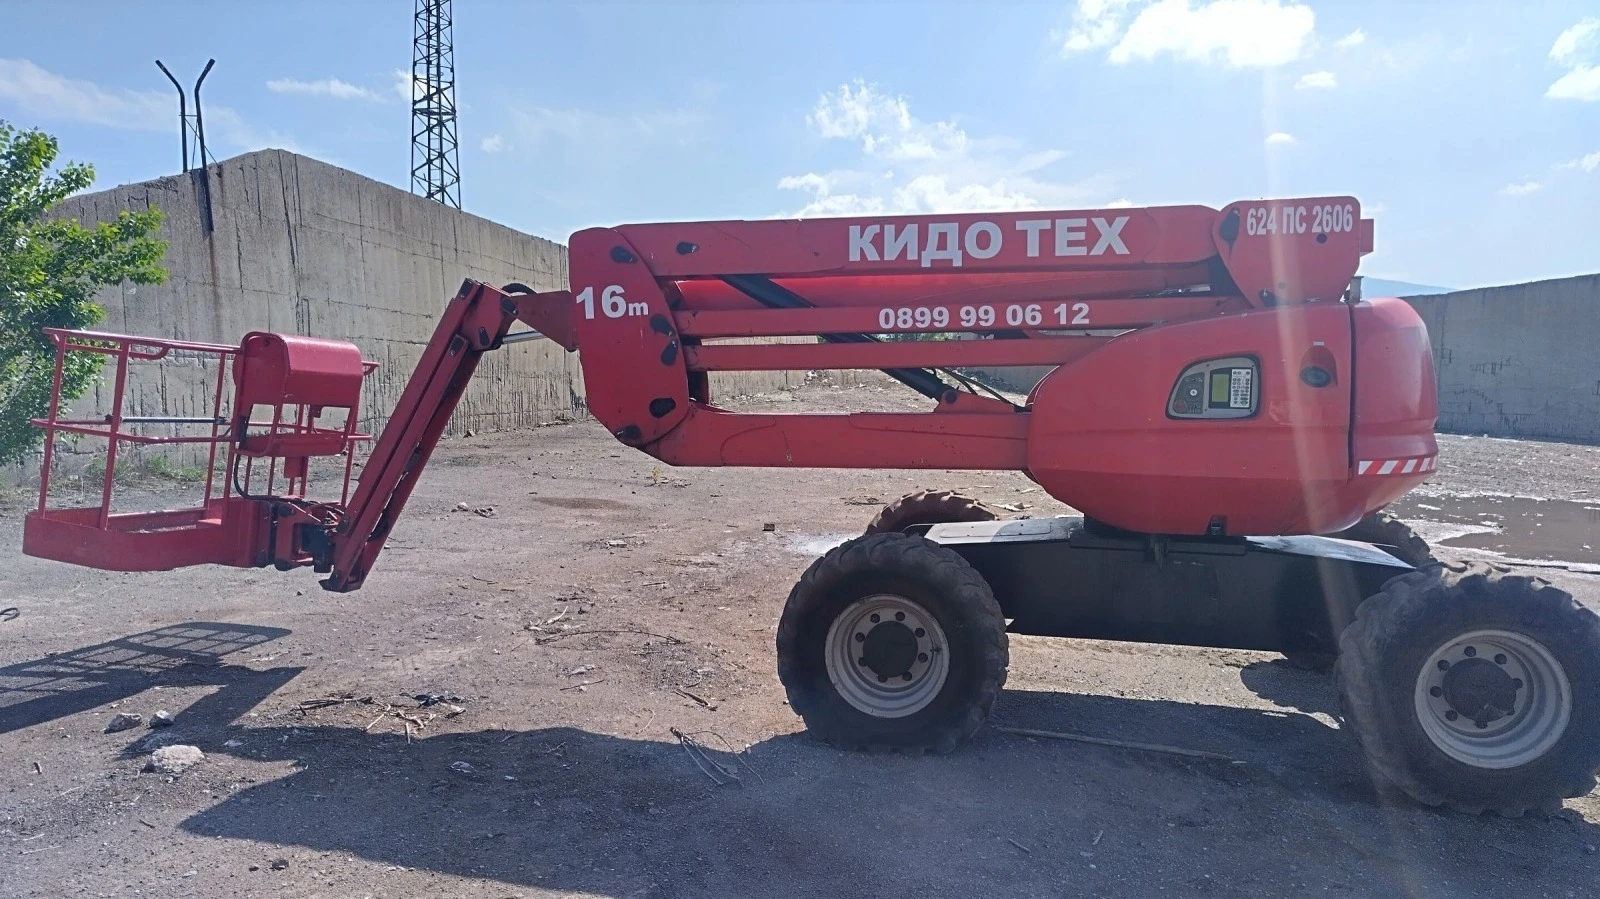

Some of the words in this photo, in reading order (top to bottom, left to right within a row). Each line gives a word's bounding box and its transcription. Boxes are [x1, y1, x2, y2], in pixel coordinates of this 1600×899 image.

[1247, 207, 1277, 236] 624
[1281, 206, 1307, 235] ПС
[1311, 204, 1353, 233] 2606
[848, 221, 1003, 268] КИДО
[1015, 216, 1131, 257] ТЕХ
[878, 306, 950, 329] 0899
[959, 305, 996, 327] 99
[1005, 304, 1043, 326] 06
[1053, 302, 1090, 325] 12
